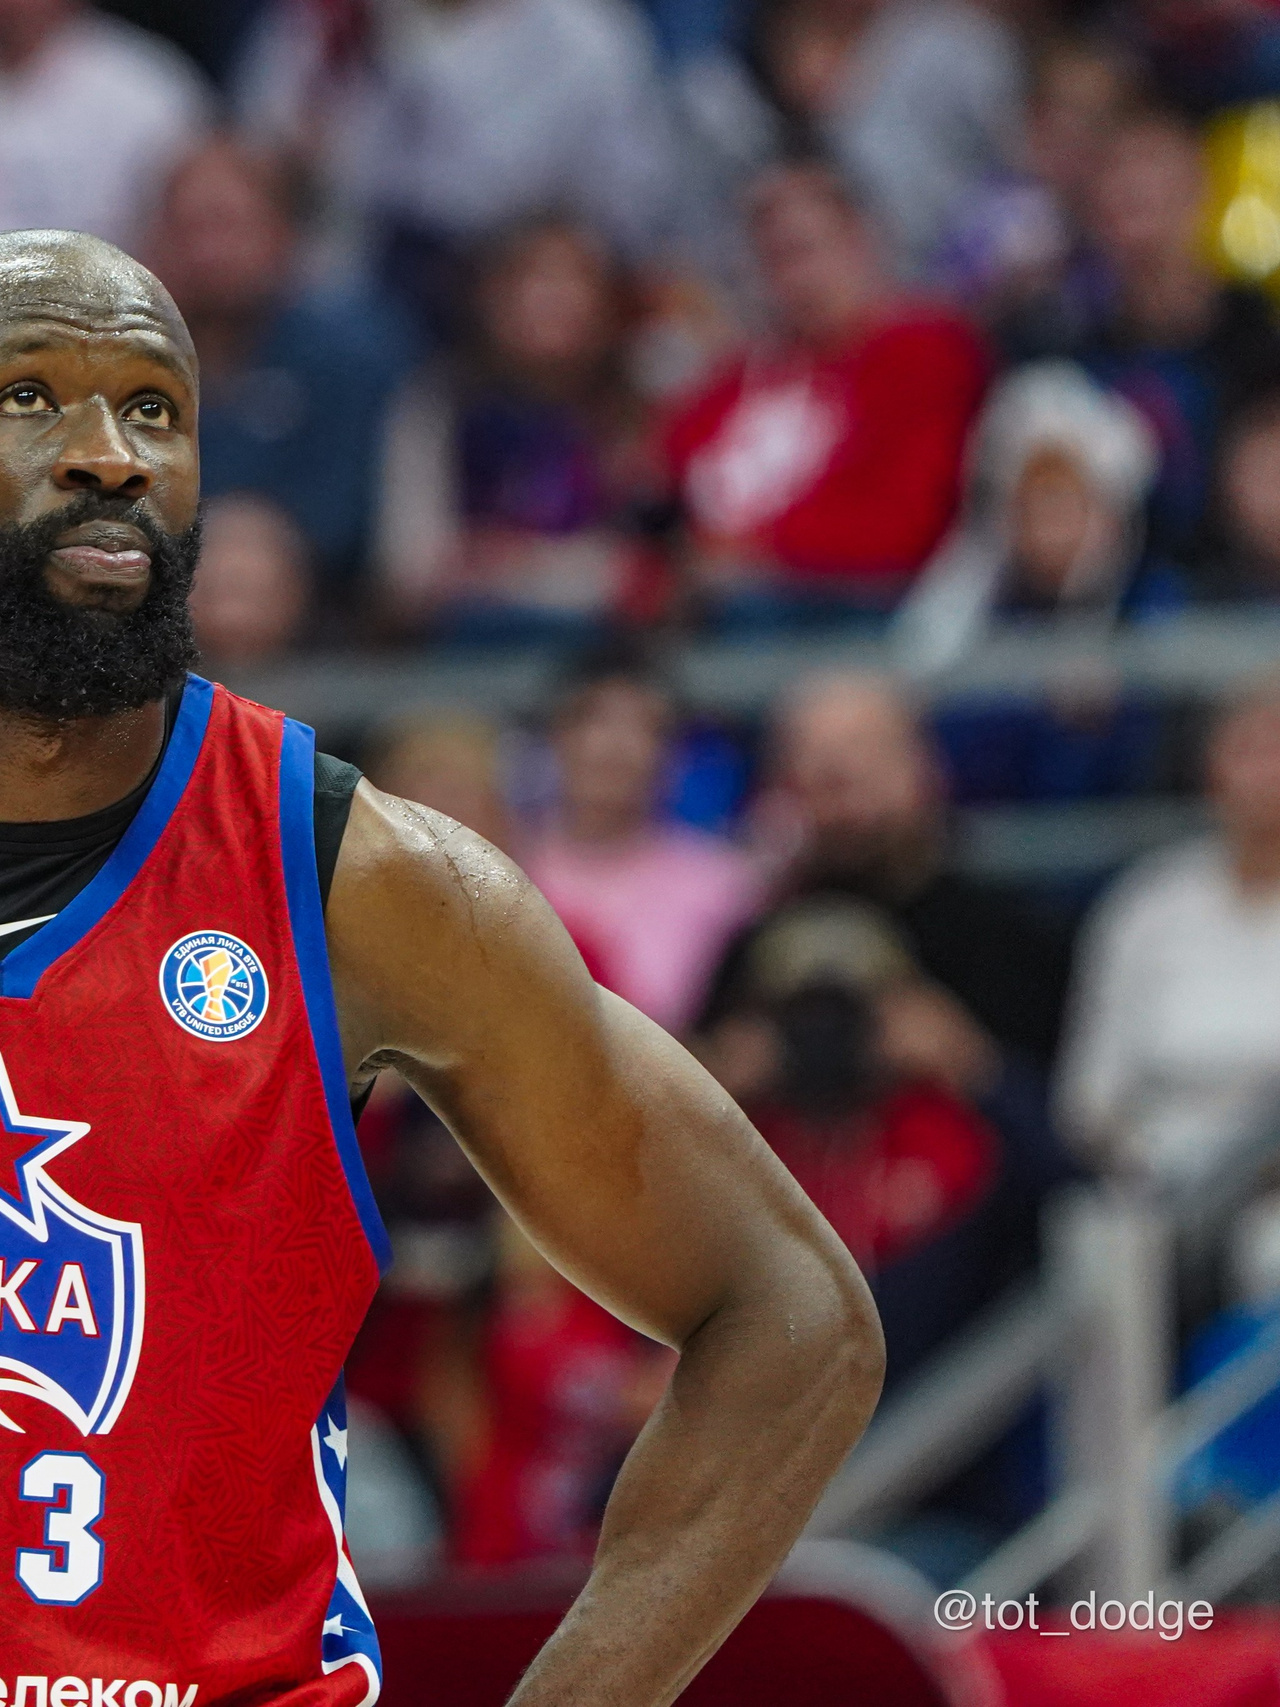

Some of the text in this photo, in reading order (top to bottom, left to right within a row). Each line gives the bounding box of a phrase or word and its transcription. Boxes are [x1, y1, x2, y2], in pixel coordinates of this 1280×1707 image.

[173, 936, 258, 974] ЕДИНАЯ ЛИГА ВТБ
[171, 998, 257, 1036] VTB UNITED LEAGUE
[16, 1449, 107, 1607] 3
